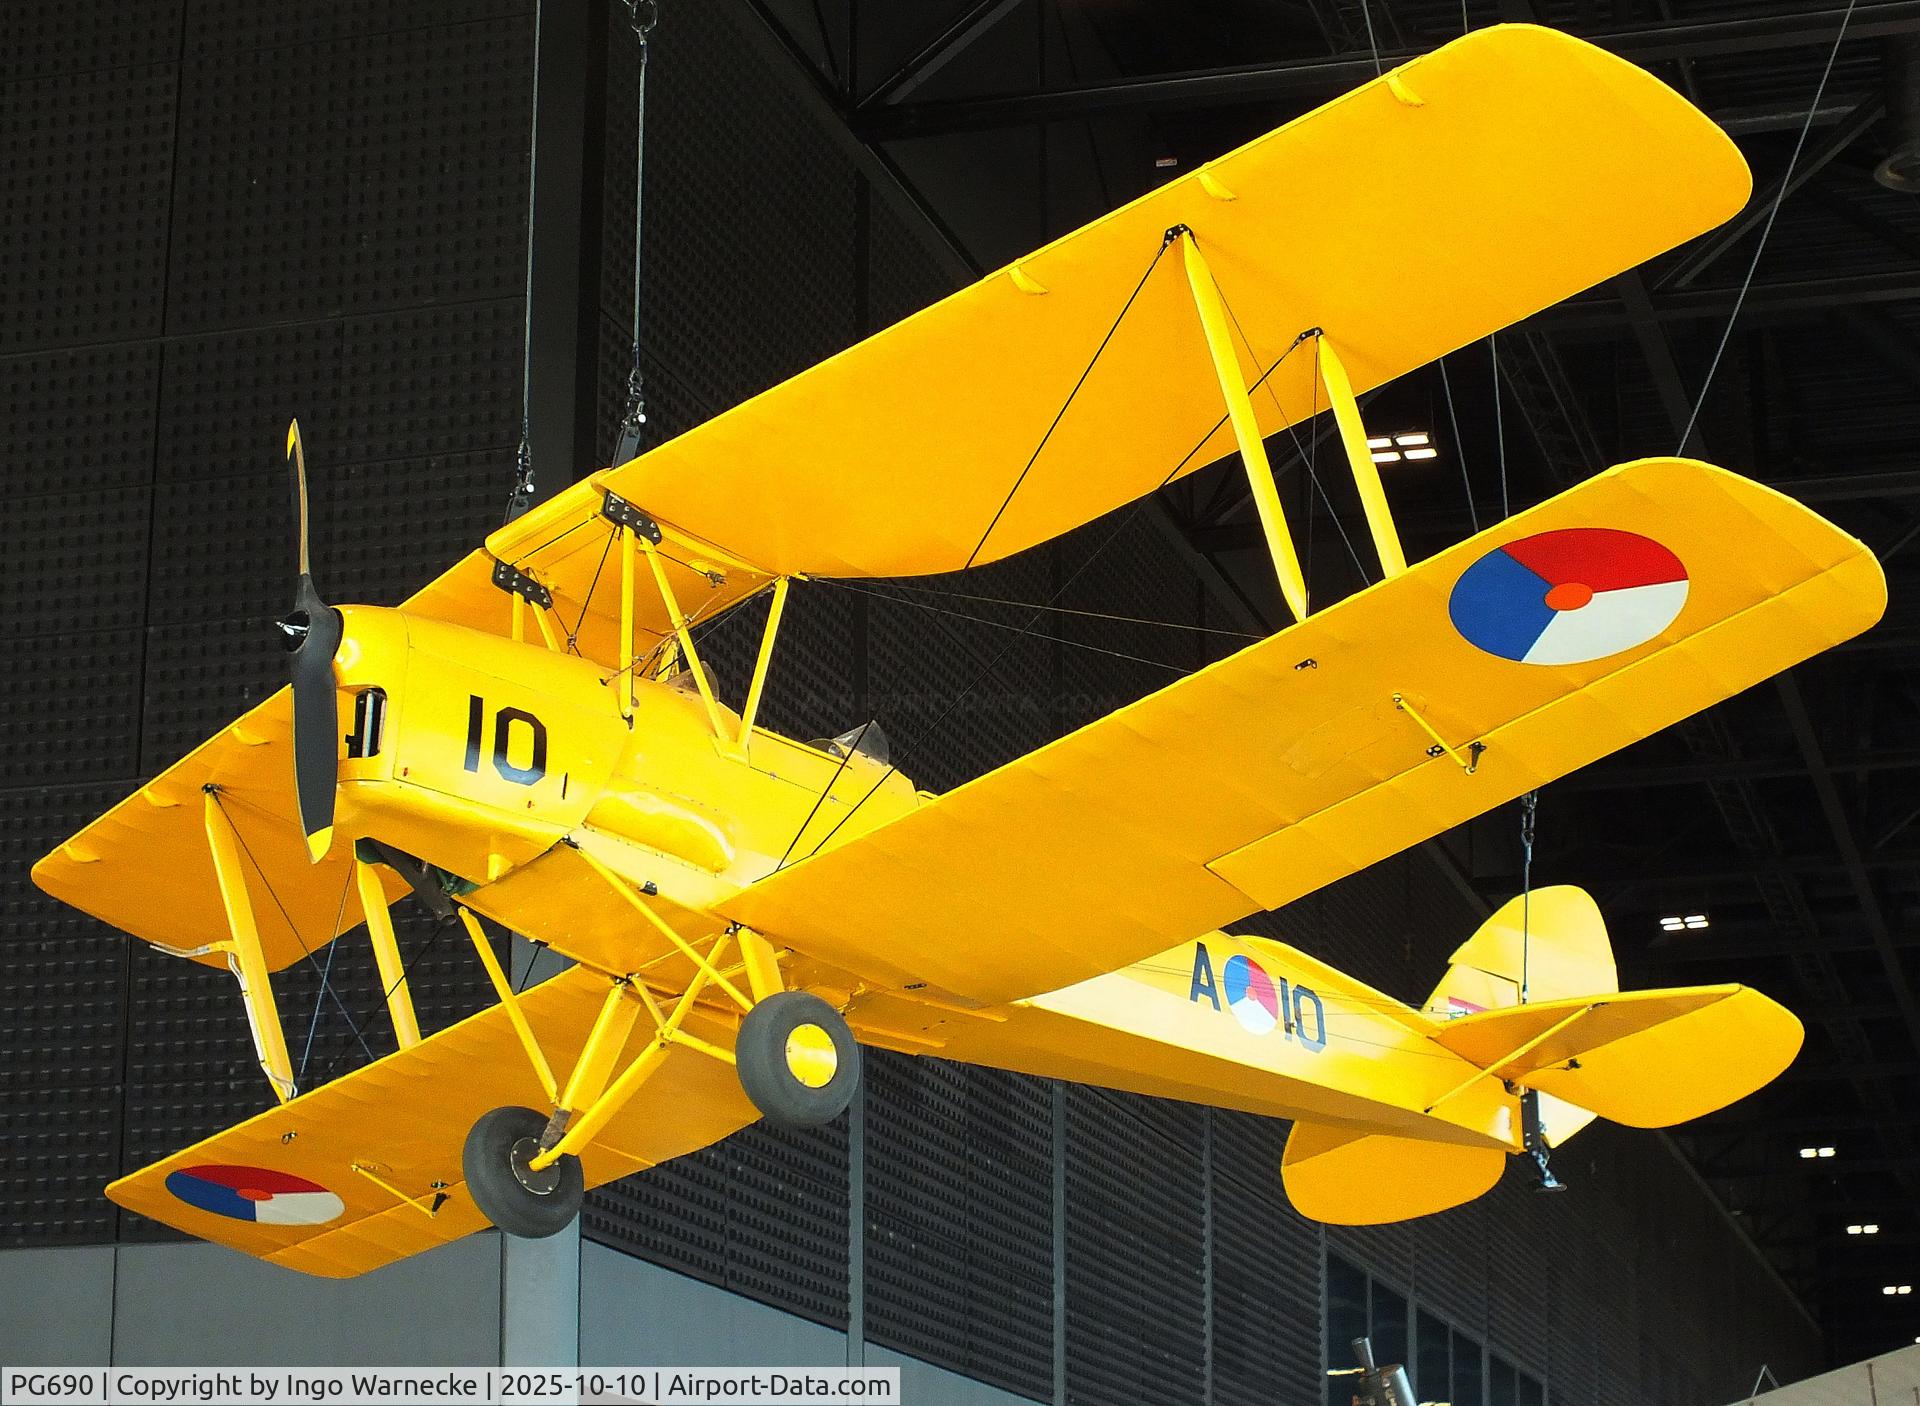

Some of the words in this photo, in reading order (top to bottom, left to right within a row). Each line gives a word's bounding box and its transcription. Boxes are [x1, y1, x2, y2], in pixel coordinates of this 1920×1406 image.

[463, 694, 547, 786] 10
[1189, 941, 1221, 1012] A
[1278, 975, 1327, 1054] 10
